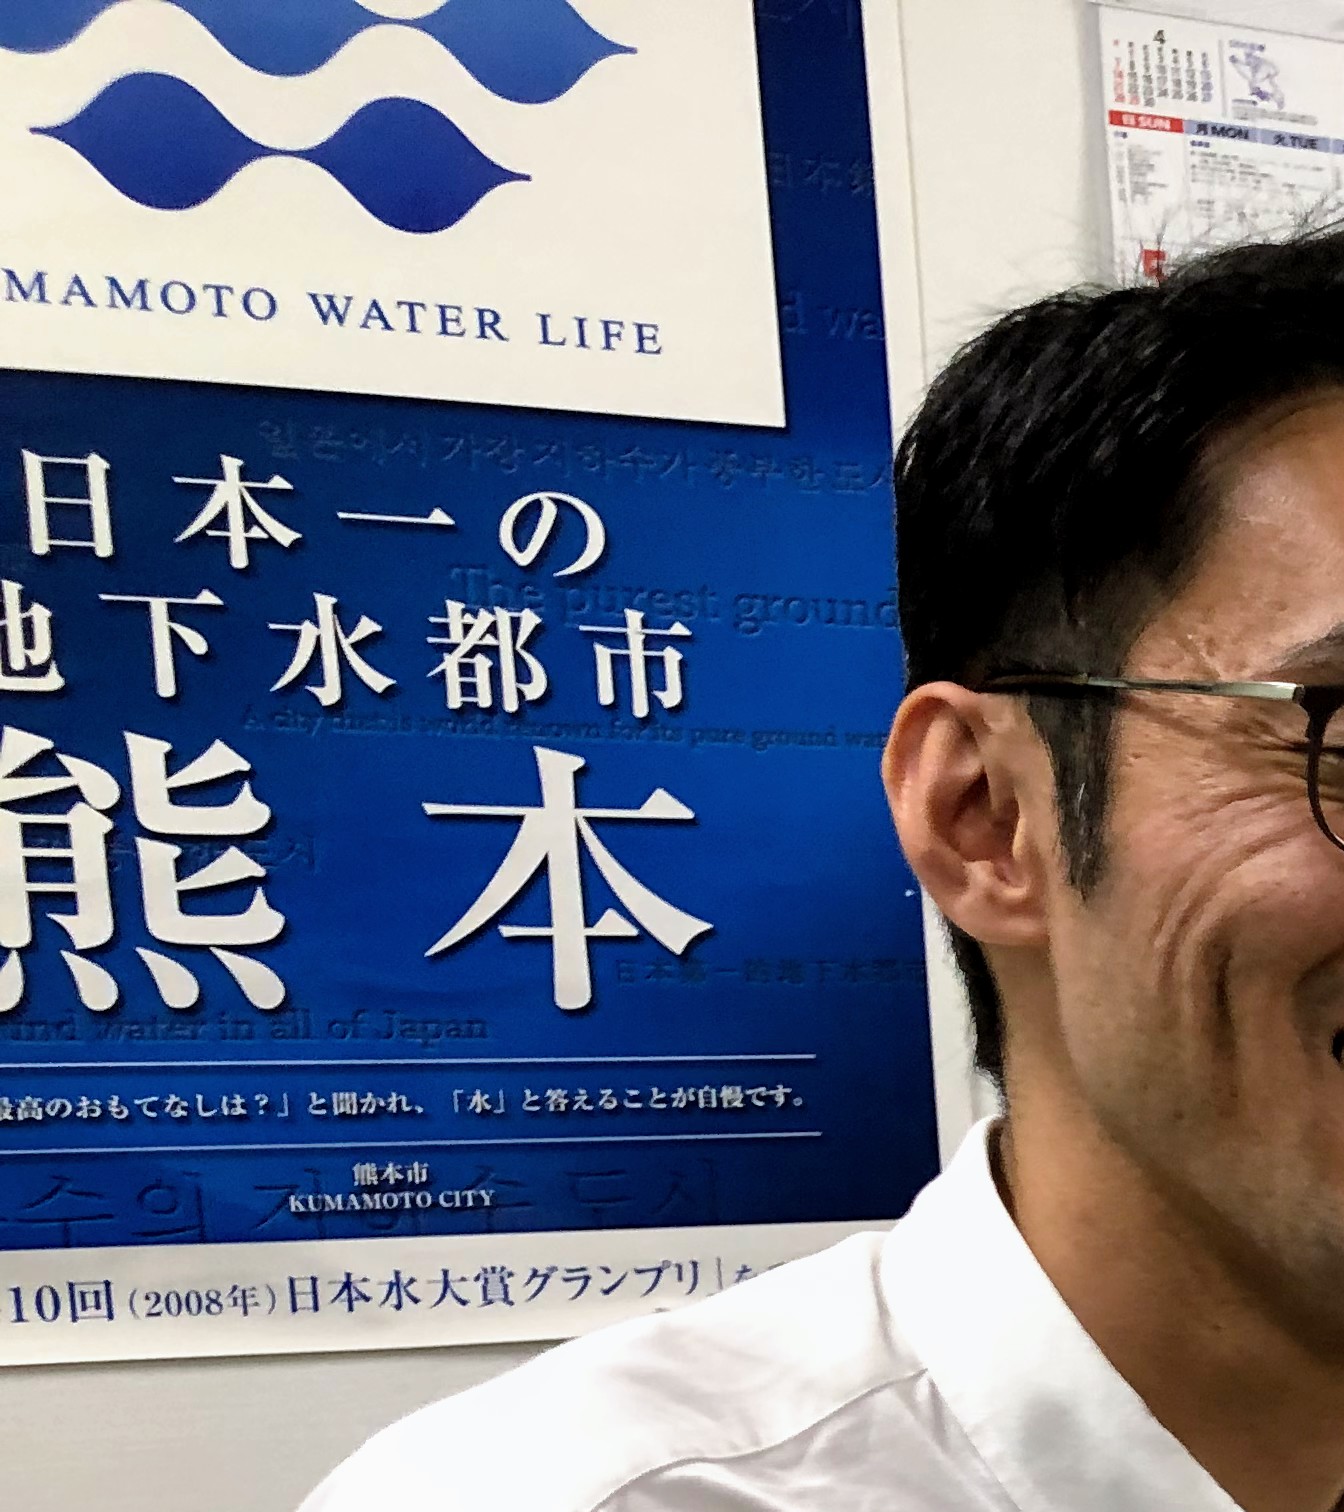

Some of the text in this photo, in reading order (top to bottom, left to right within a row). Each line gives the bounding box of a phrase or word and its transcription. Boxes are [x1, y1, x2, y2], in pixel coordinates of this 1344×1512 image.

[1153, 30, 1166, 44] 4
[1211, 126, 1250, 140] MON
[1290, 136, 1319, 149] TUE
[307, 290, 509, 343] WATER
[538, 312, 664, 356] LIFE
[21, 448, 608, 579] 日本一の
[0, 726, 714, 1013] 熊本
[327, 1007, 370, 1038] of
[382, 1009, 490, 1048] Japan
[352, 1160, 430, 1185] 熊本市
[289, 1188, 496, 1213] KUMAMOTO CITY
